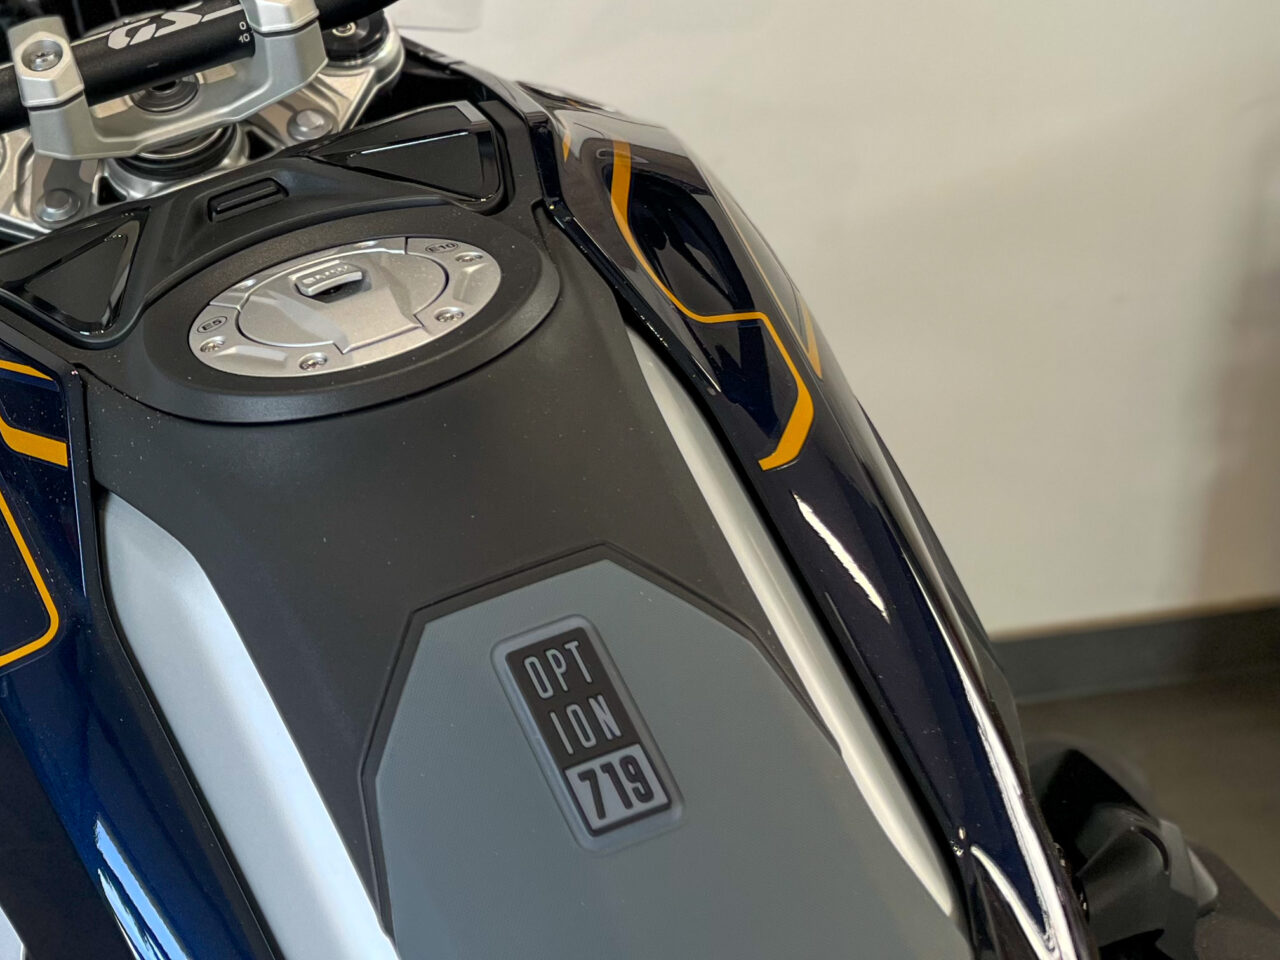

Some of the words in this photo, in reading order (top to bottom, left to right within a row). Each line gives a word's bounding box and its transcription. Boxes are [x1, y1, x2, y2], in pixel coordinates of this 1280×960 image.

[238, 33, 250, 43] 10
[523, 640, 593, 700] OPT
[549, 694, 622, 755] ION
[577, 754, 655, 820] 719
